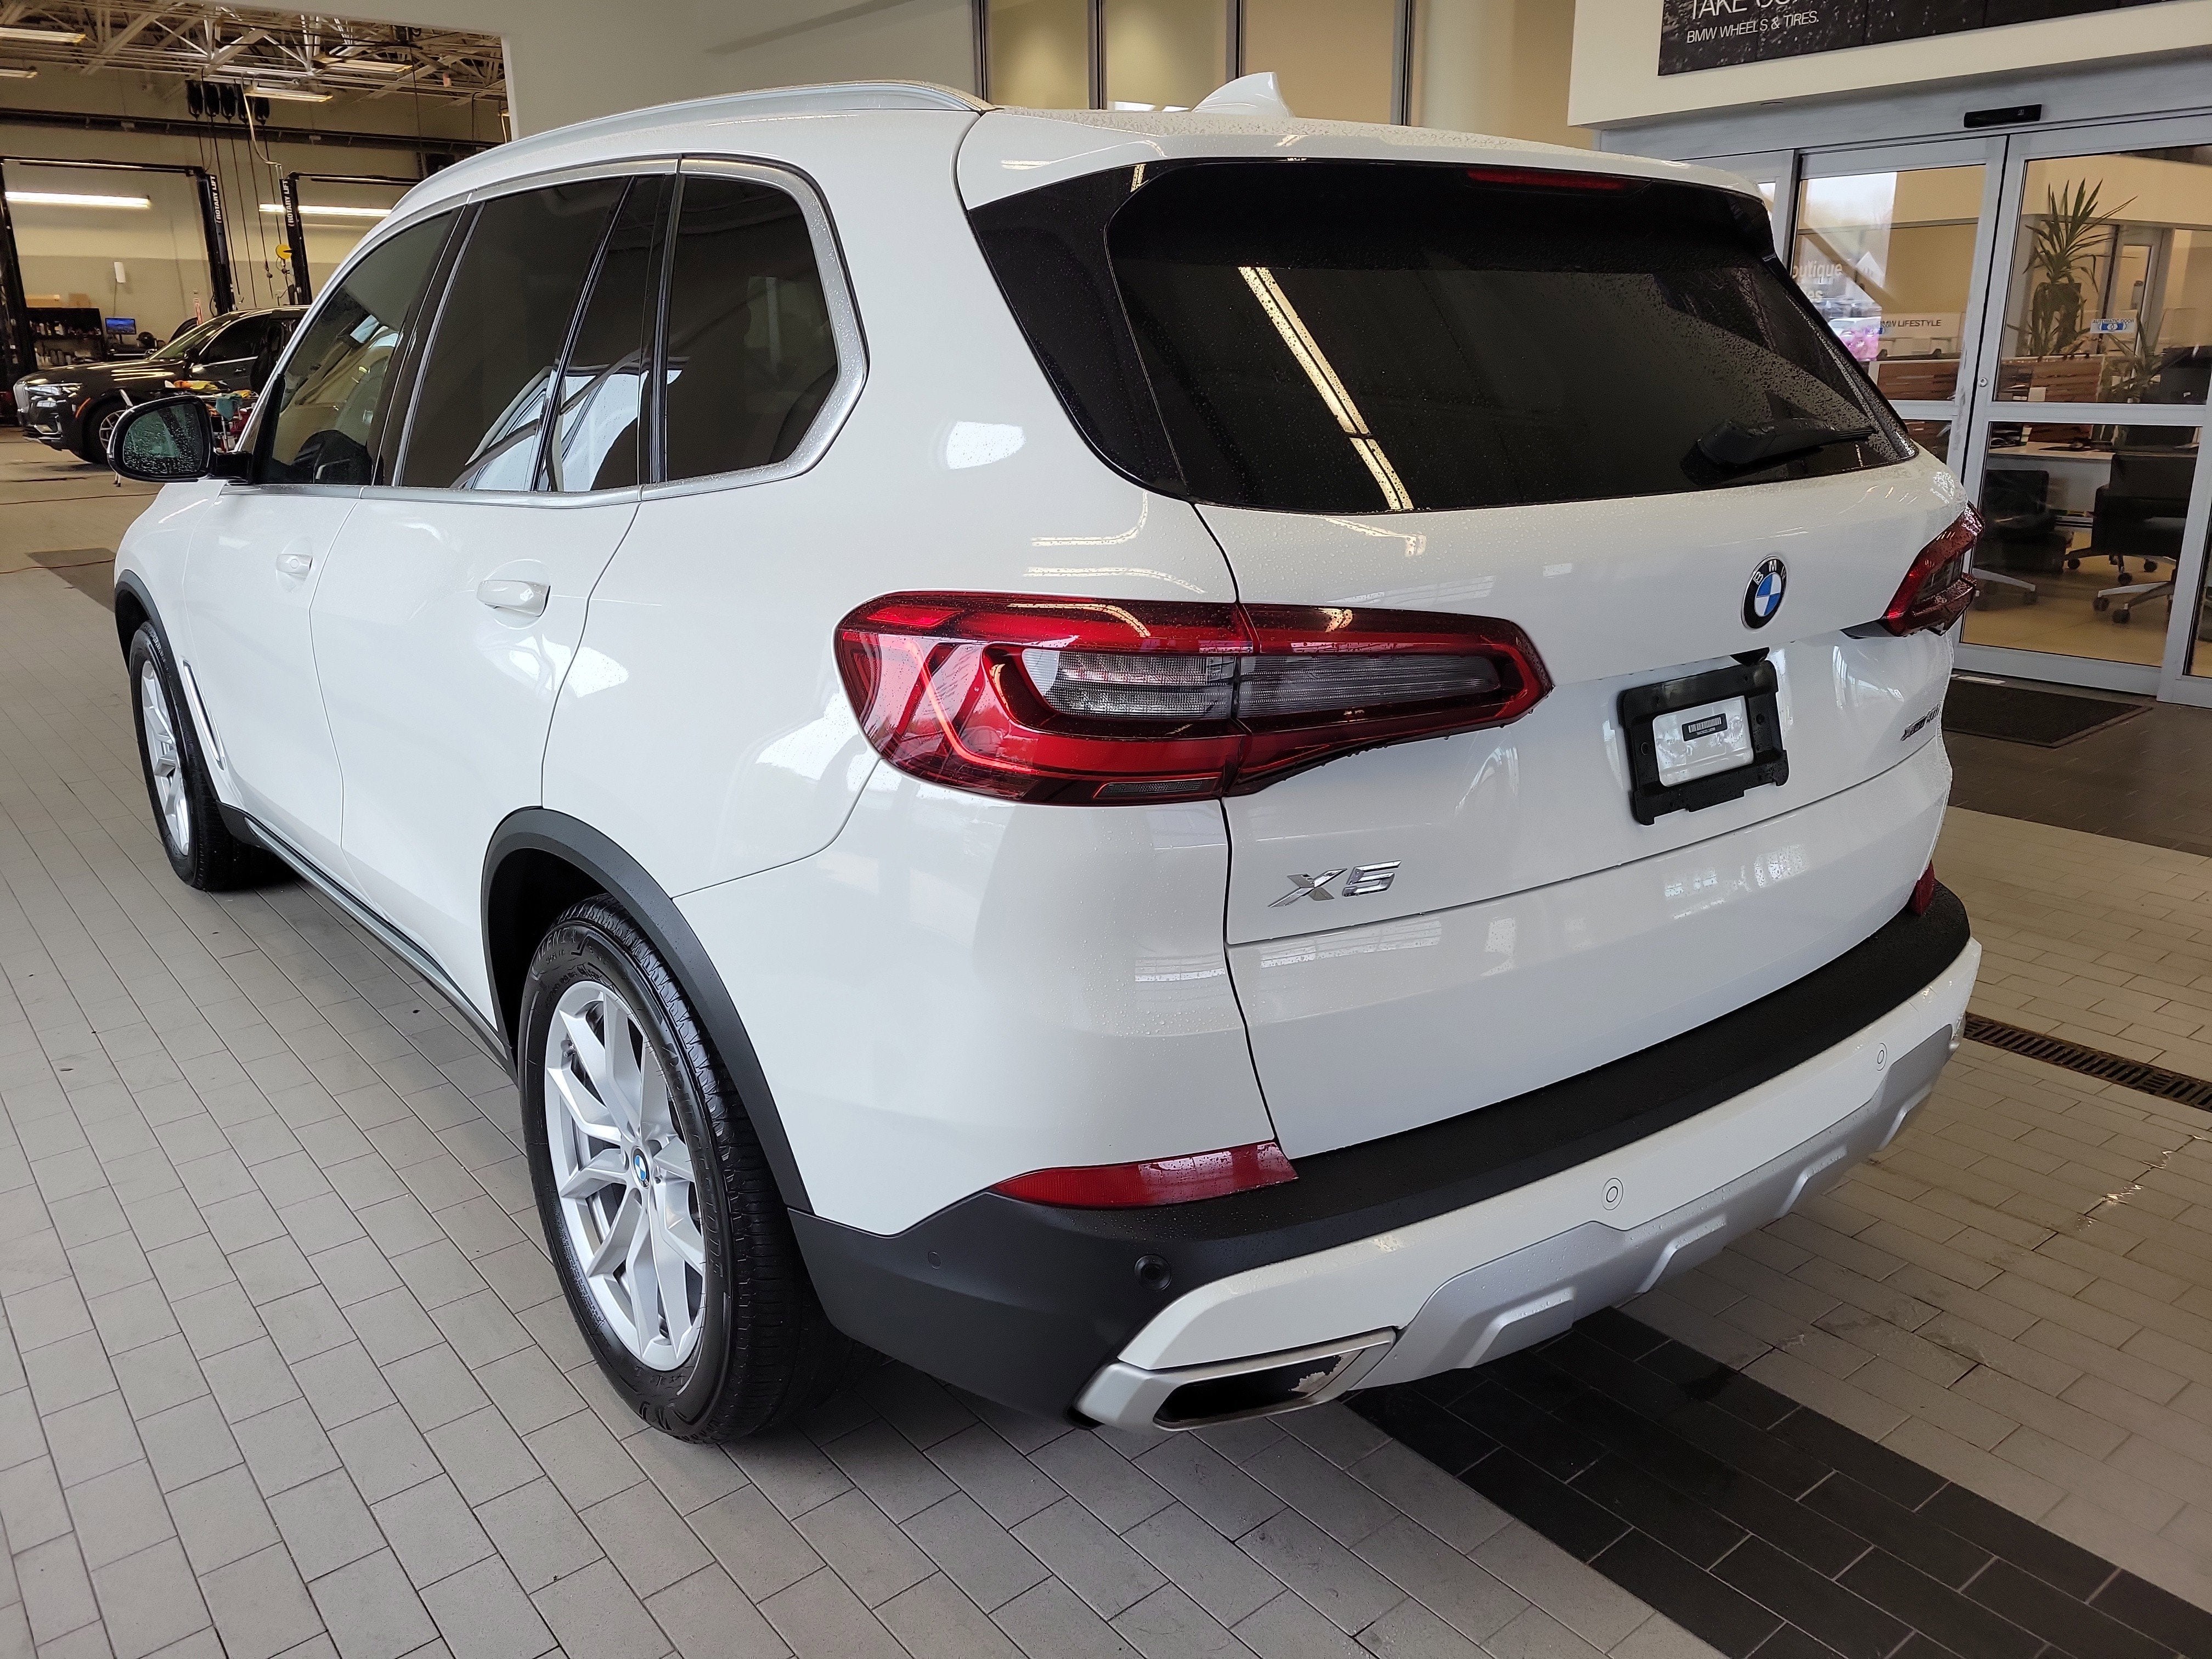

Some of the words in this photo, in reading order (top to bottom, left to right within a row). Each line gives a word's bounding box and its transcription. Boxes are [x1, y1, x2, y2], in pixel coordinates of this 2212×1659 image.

[1687, 27, 1717, 43] BMW
[1720, 19, 1768, 38] WHEELS
[1770, 16, 1780, 30] &
[1784, 10, 1819, 27] TIRES.
[213, 192, 222, 220] ROTARY
[285, 196, 295, 224] ROTARY
[1752, 559, 1787, 585] BMW
[1268, 860, 1402, 908] X5
